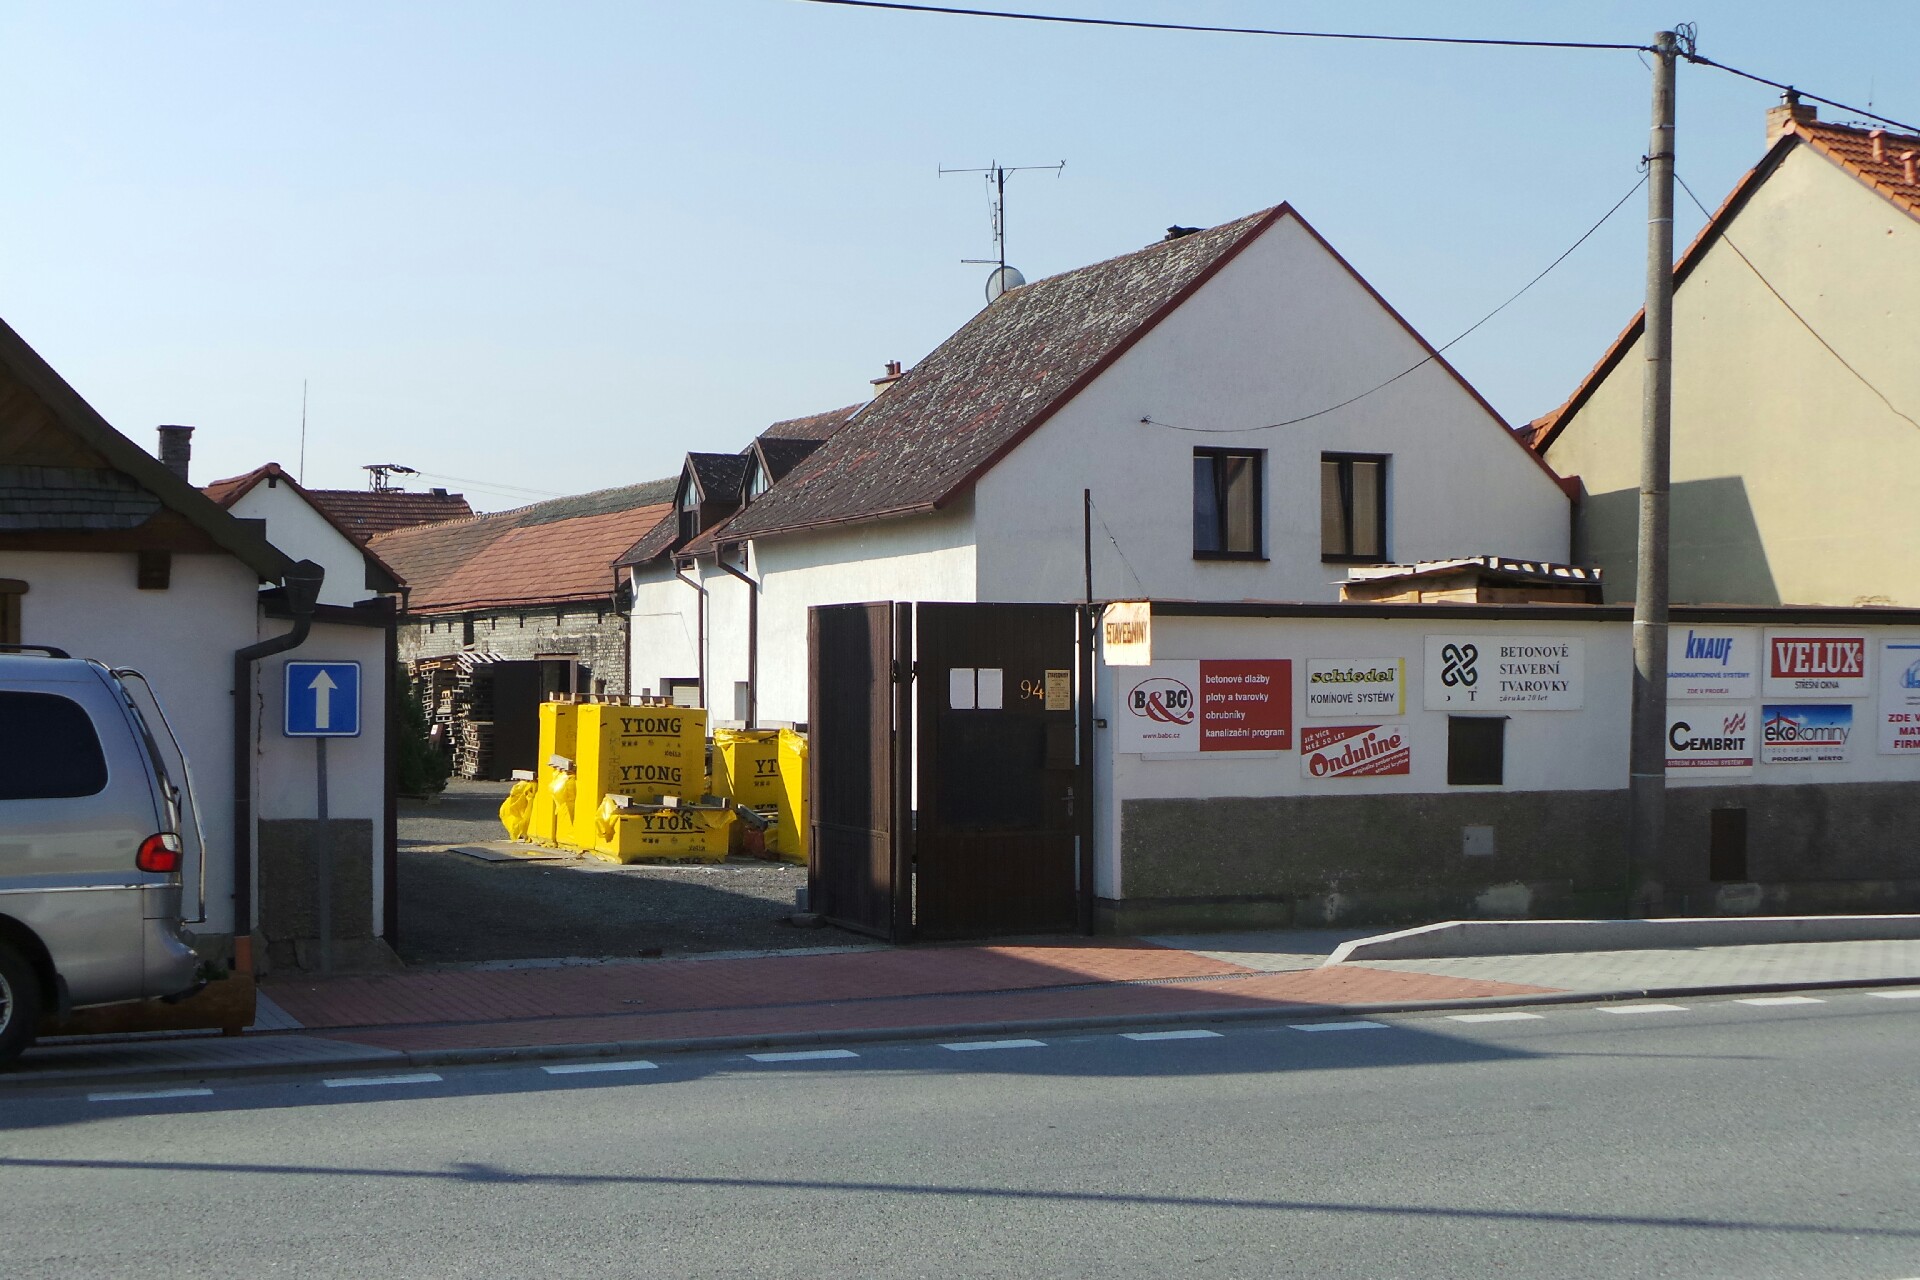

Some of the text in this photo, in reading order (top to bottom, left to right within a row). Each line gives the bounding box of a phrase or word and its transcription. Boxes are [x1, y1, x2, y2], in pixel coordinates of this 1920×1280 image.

[1500, 644, 1569, 657] BETONOVÉ
[1685, 630, 1733, 665] KNAUF
[1776, 642, 1860, 673] VELUX
[1500, 661, 1560, 675] STAVEBNÍ
[1205, 674, 1270, 685] betonové dlažby
[1310, 668, 1395, 683] schiedel
[1020, 679, 1044, 700] 94
[1500, 680, 1570, 692] TVAROVKY
[1205, 692, 1226, 703] ploty
[1235, 692, 1269, 702] tvarovky
[1311, 690, 1394, 703] KOMÍNOVÉ SYSTÉMY
[1205, 709, 1246, 721] obrubníky
[1888, 714, 1911, 723] ZDE
[620, 717, 682, 733] YTONG
[1205, 728, 1285, 738] kanalizační program
[1309, 733, 1401, 777] Onduline
[620, 765, 682, 782] YTONG
